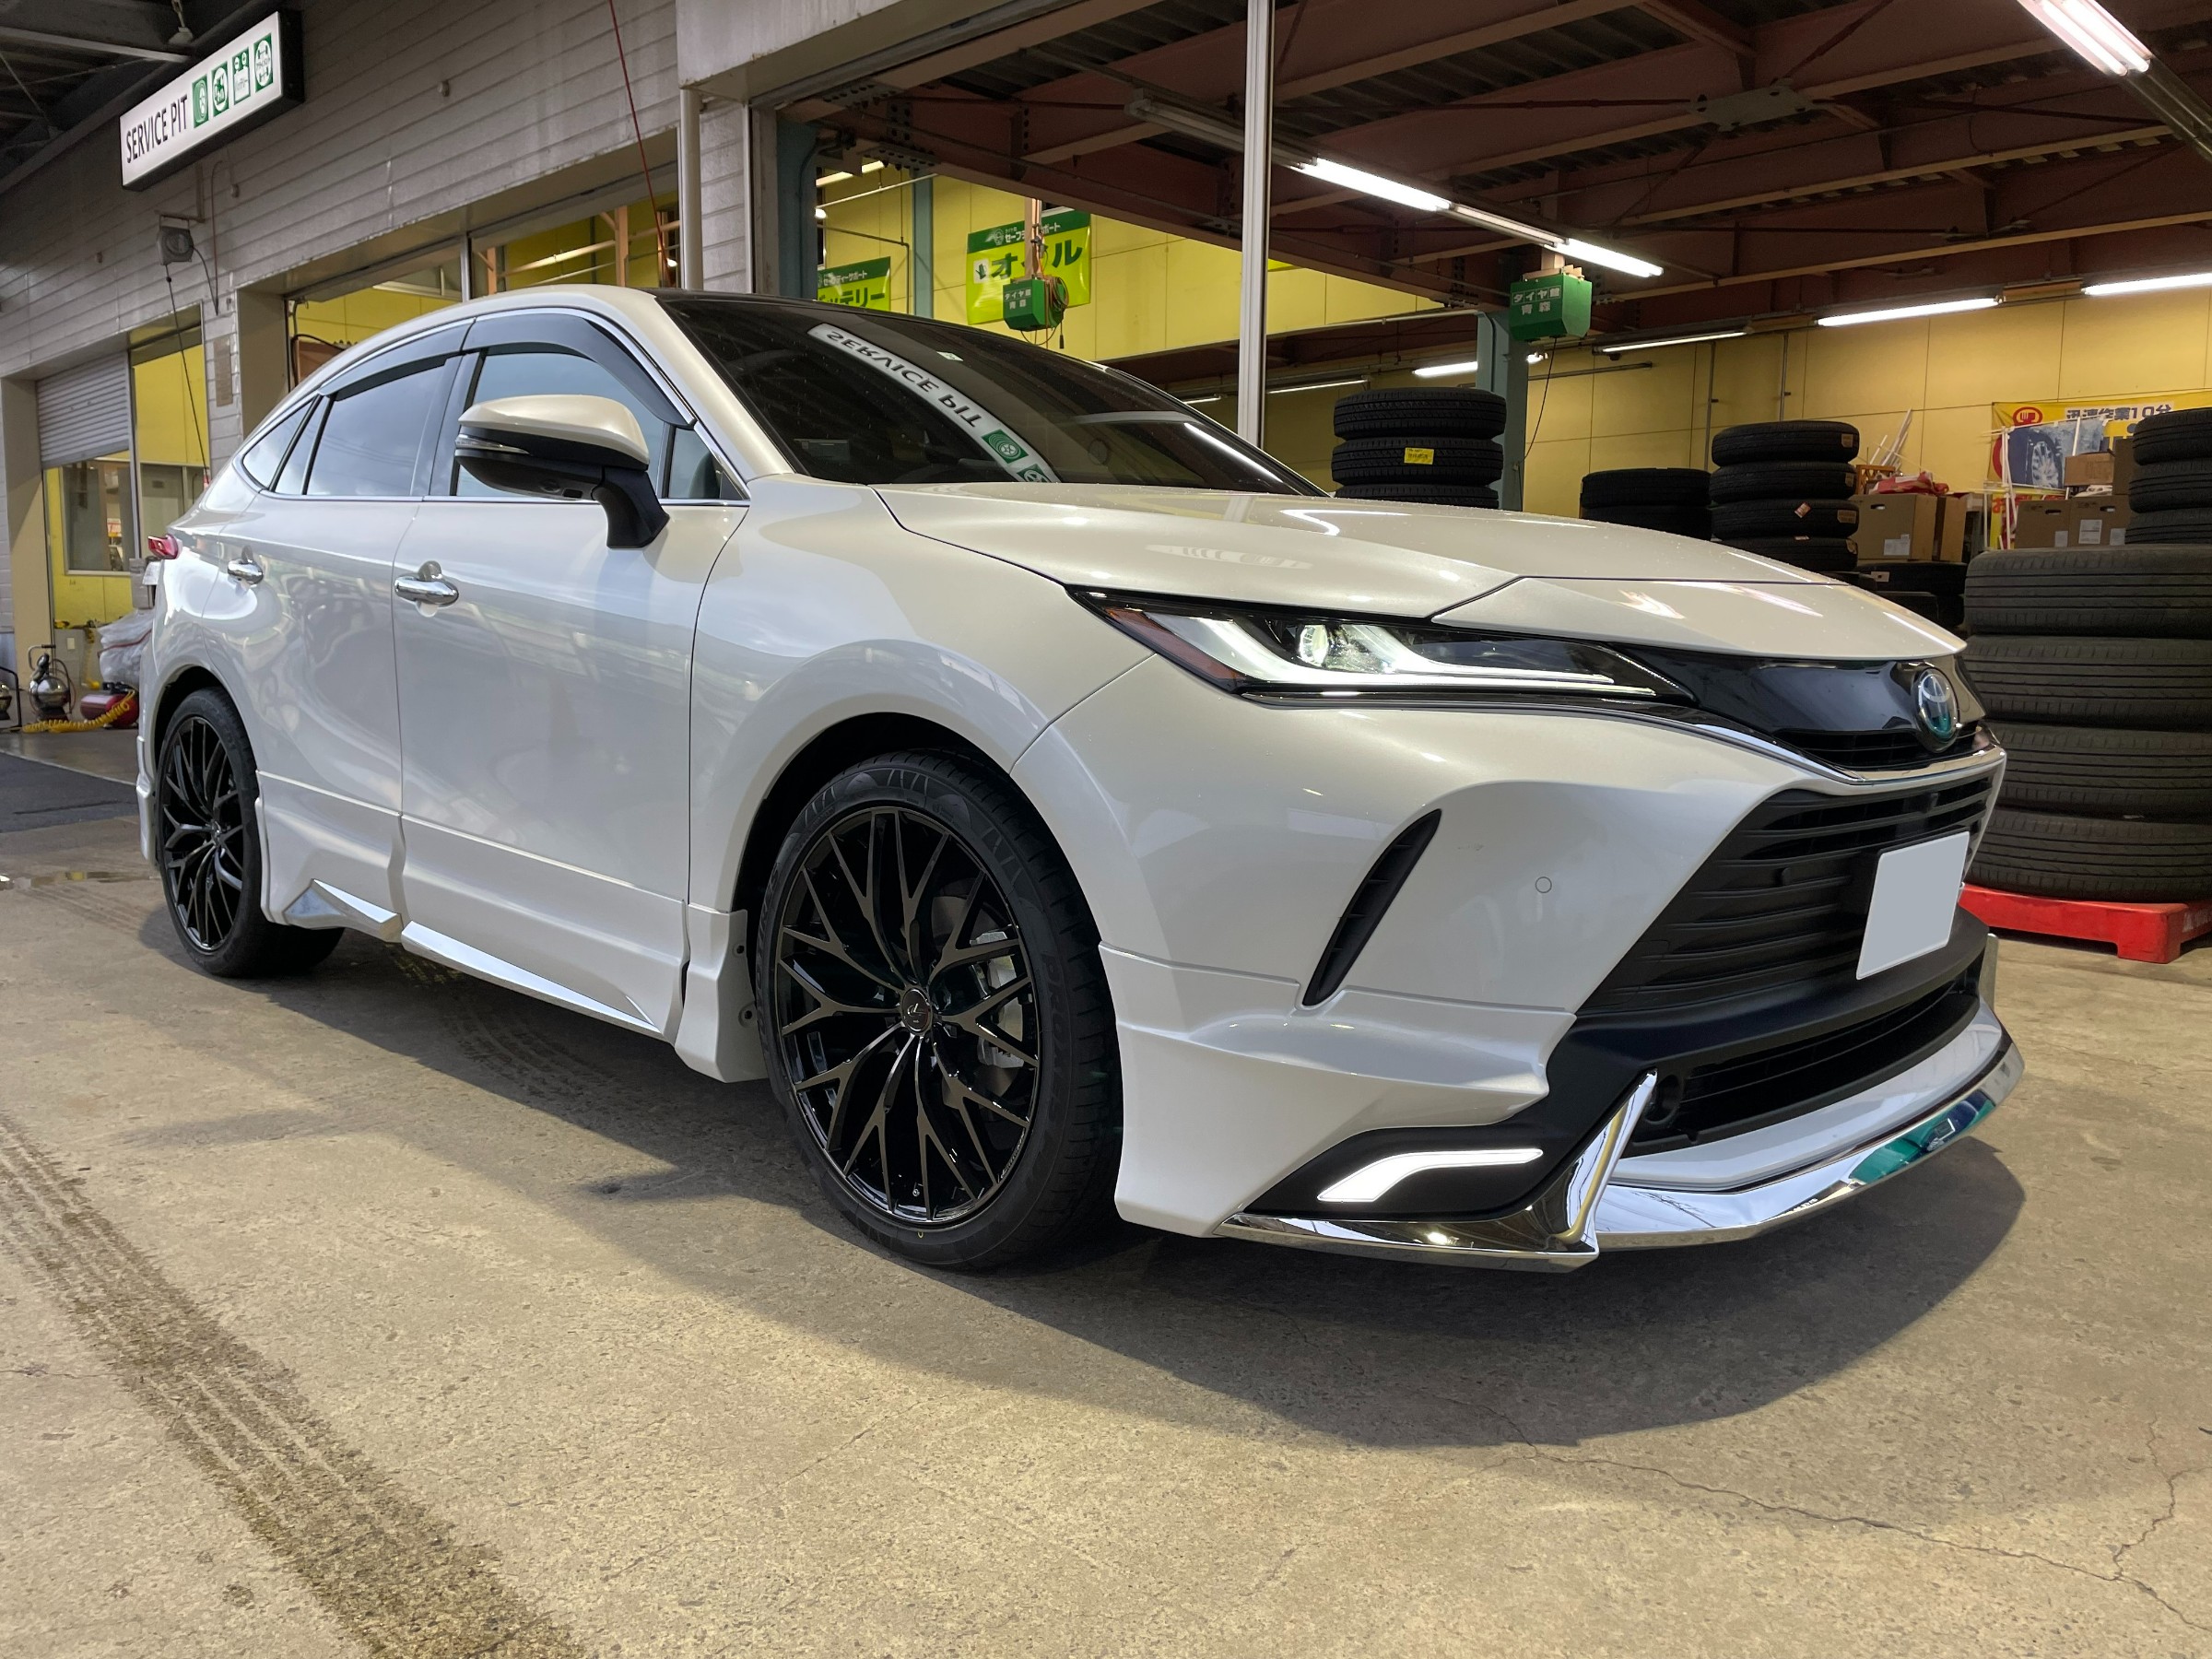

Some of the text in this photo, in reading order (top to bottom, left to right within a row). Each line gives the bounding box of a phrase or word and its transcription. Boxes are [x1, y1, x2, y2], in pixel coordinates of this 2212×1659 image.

[126, 94, 188, 163] SERVICE PIT
[991, 239, 1083, 278] オル
